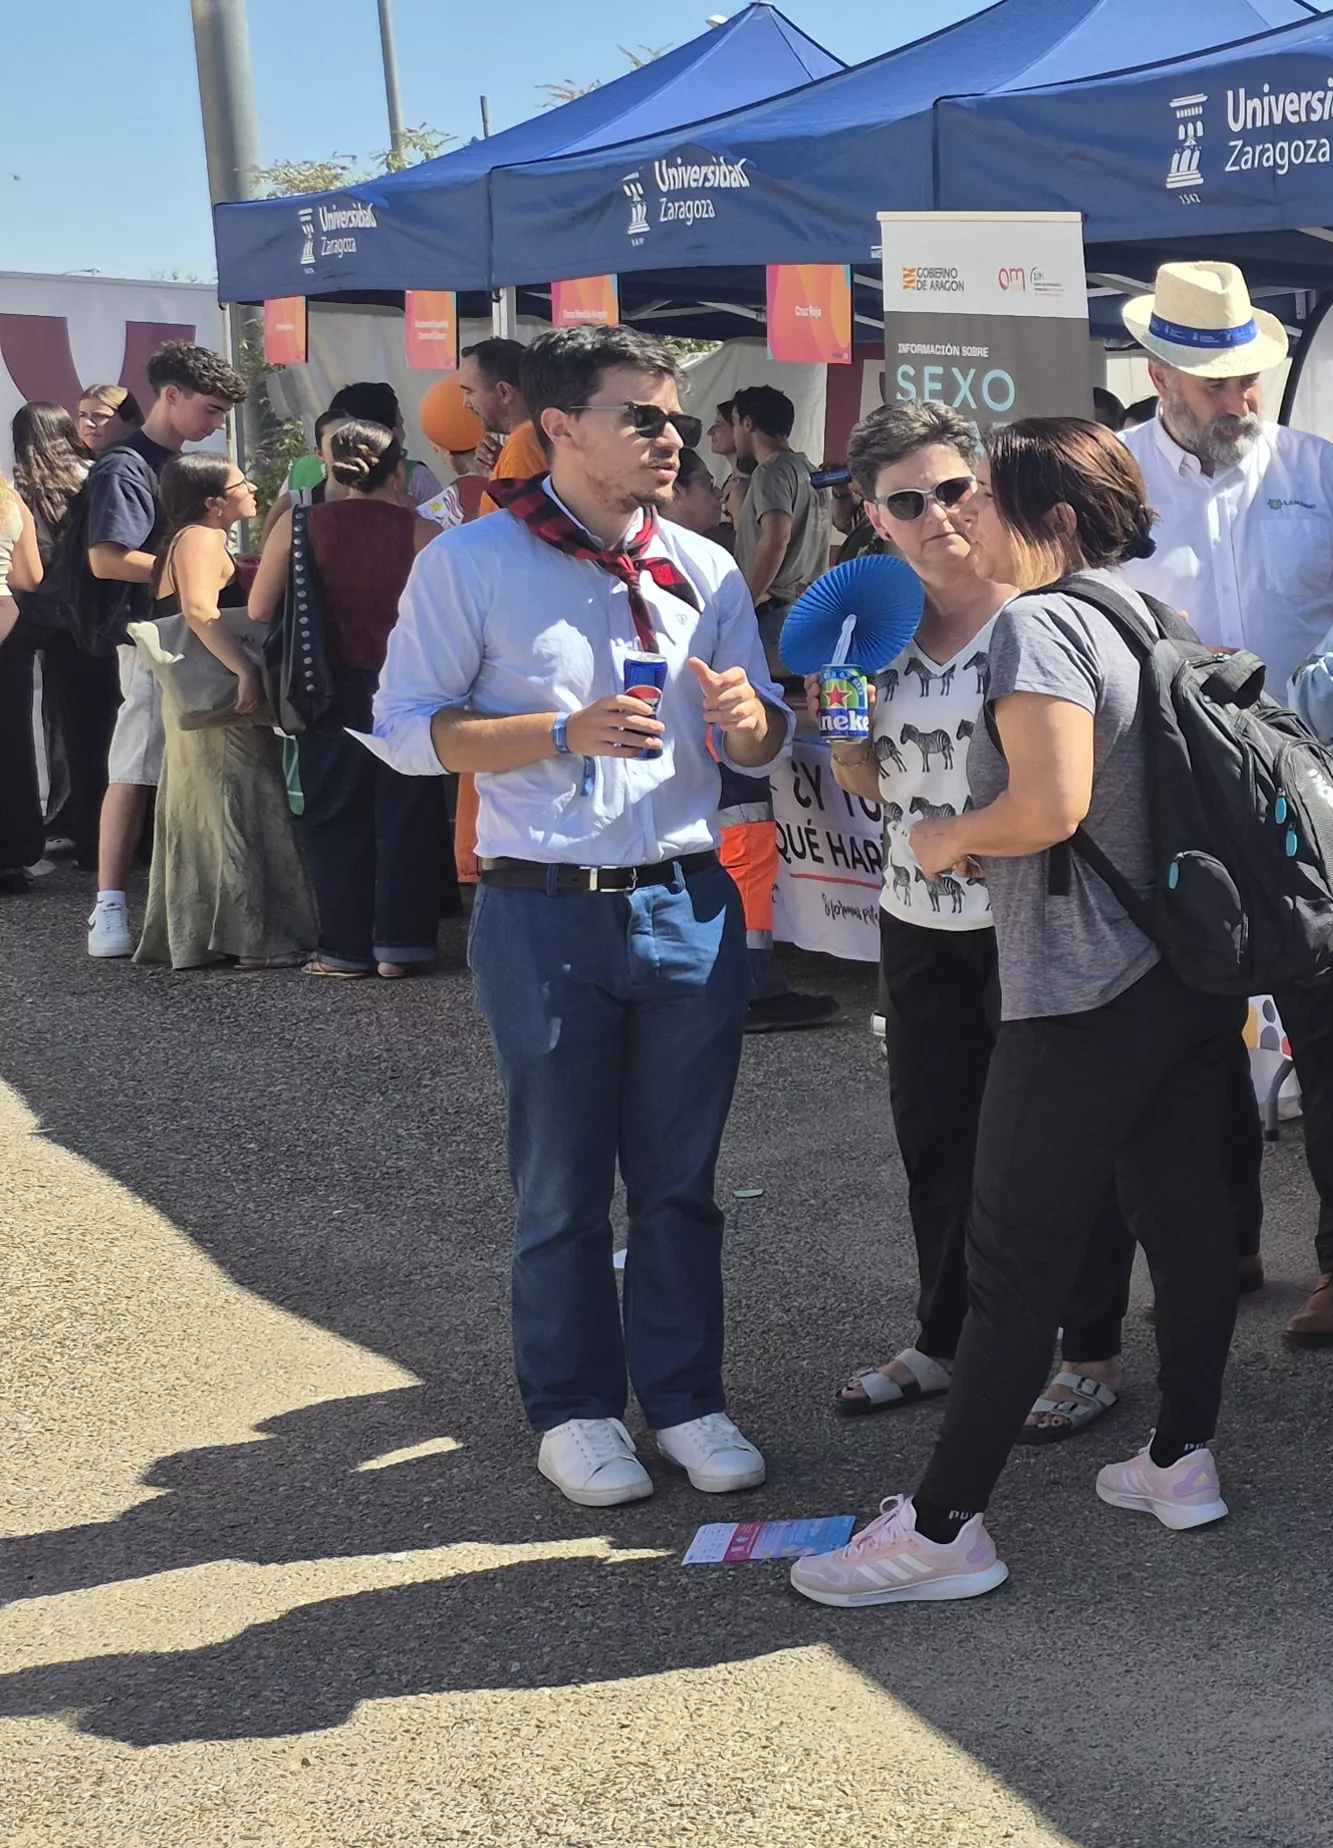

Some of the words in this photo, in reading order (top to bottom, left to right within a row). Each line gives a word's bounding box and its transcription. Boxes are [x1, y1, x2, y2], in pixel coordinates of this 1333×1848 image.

[1224, 137, 1331, 176] Zaragoza
[653, 155, 751, 193] Universidad
[318, 202, 378, 232] Universidad
[658, 197, 716, 227] Zaragoza
[320, 236, 357, 259] Zaragoza
[916, 266, 958, 279] GOBIERNO
[916, 280, 927, 292] DE
[897, 343, 960, 357] INFORMACIÓN
[961, 344, 990, 358] SOBRE
[896, 363, 1016, 413] SEXO
[775, 818, 825, 865] QUÉ
[825, 830, 884, 876] HAR
[948, 1509, 974, 1521] PU
